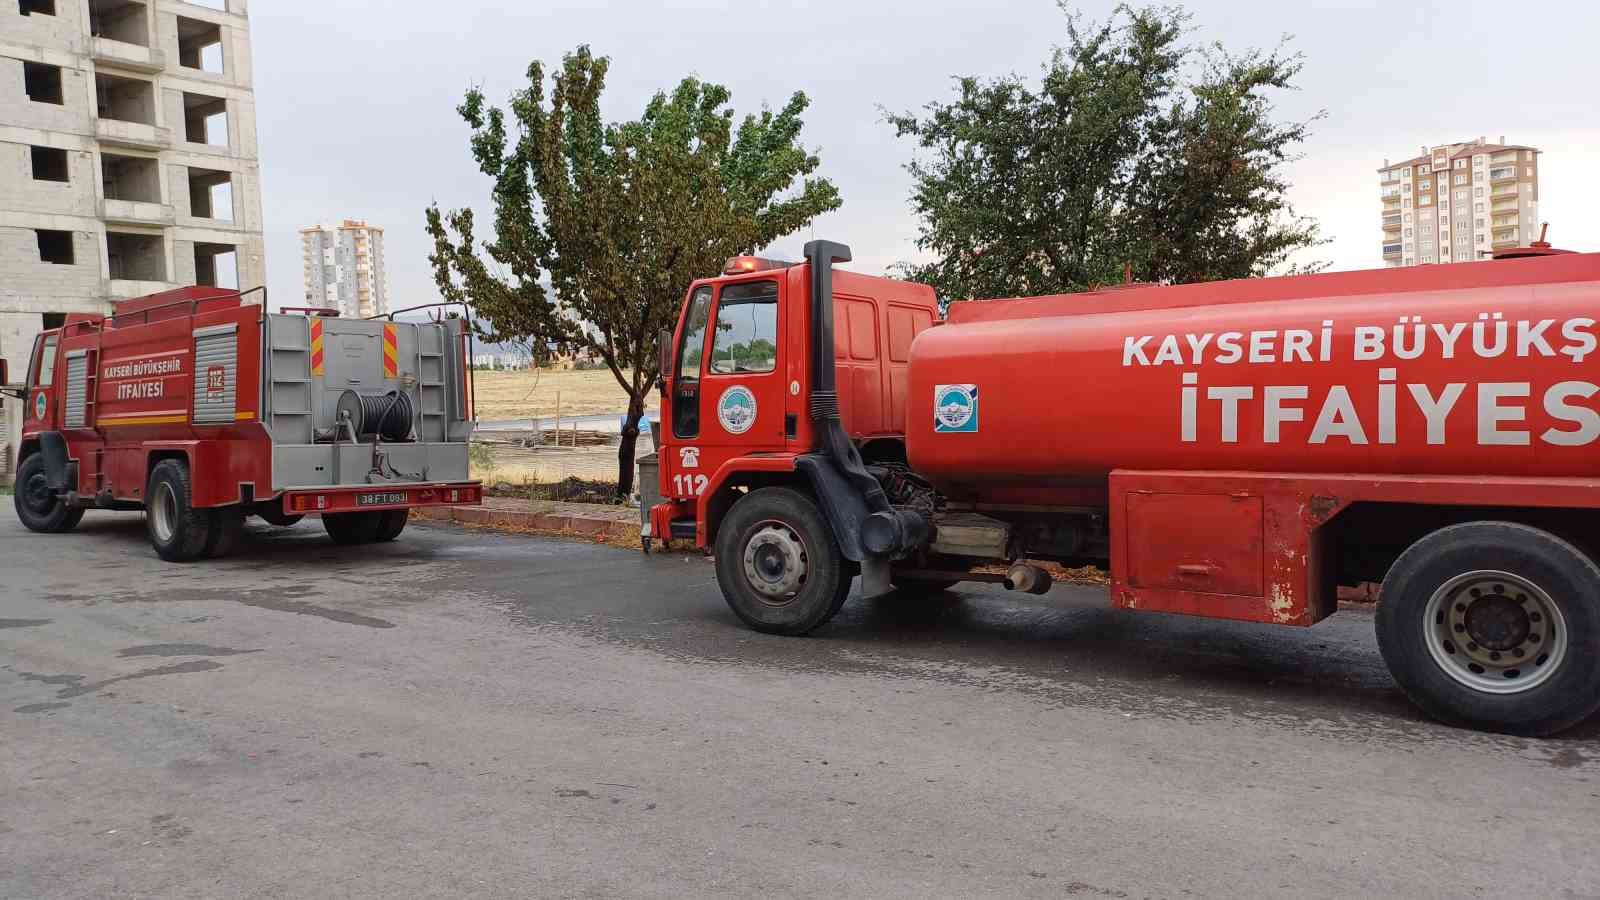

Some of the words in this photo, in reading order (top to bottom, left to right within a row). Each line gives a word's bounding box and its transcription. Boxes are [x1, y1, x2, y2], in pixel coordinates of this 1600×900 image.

[1122, 319, 1334, 367] KAYSERİ
[1353, 312, 1598, 363] BÜYÜKŞ
[117, 378, 164, 399] İTFAİYESİ
[1180, 367, 1600, 446] İTFAİYES
[673, 474, 709, 496] 112
